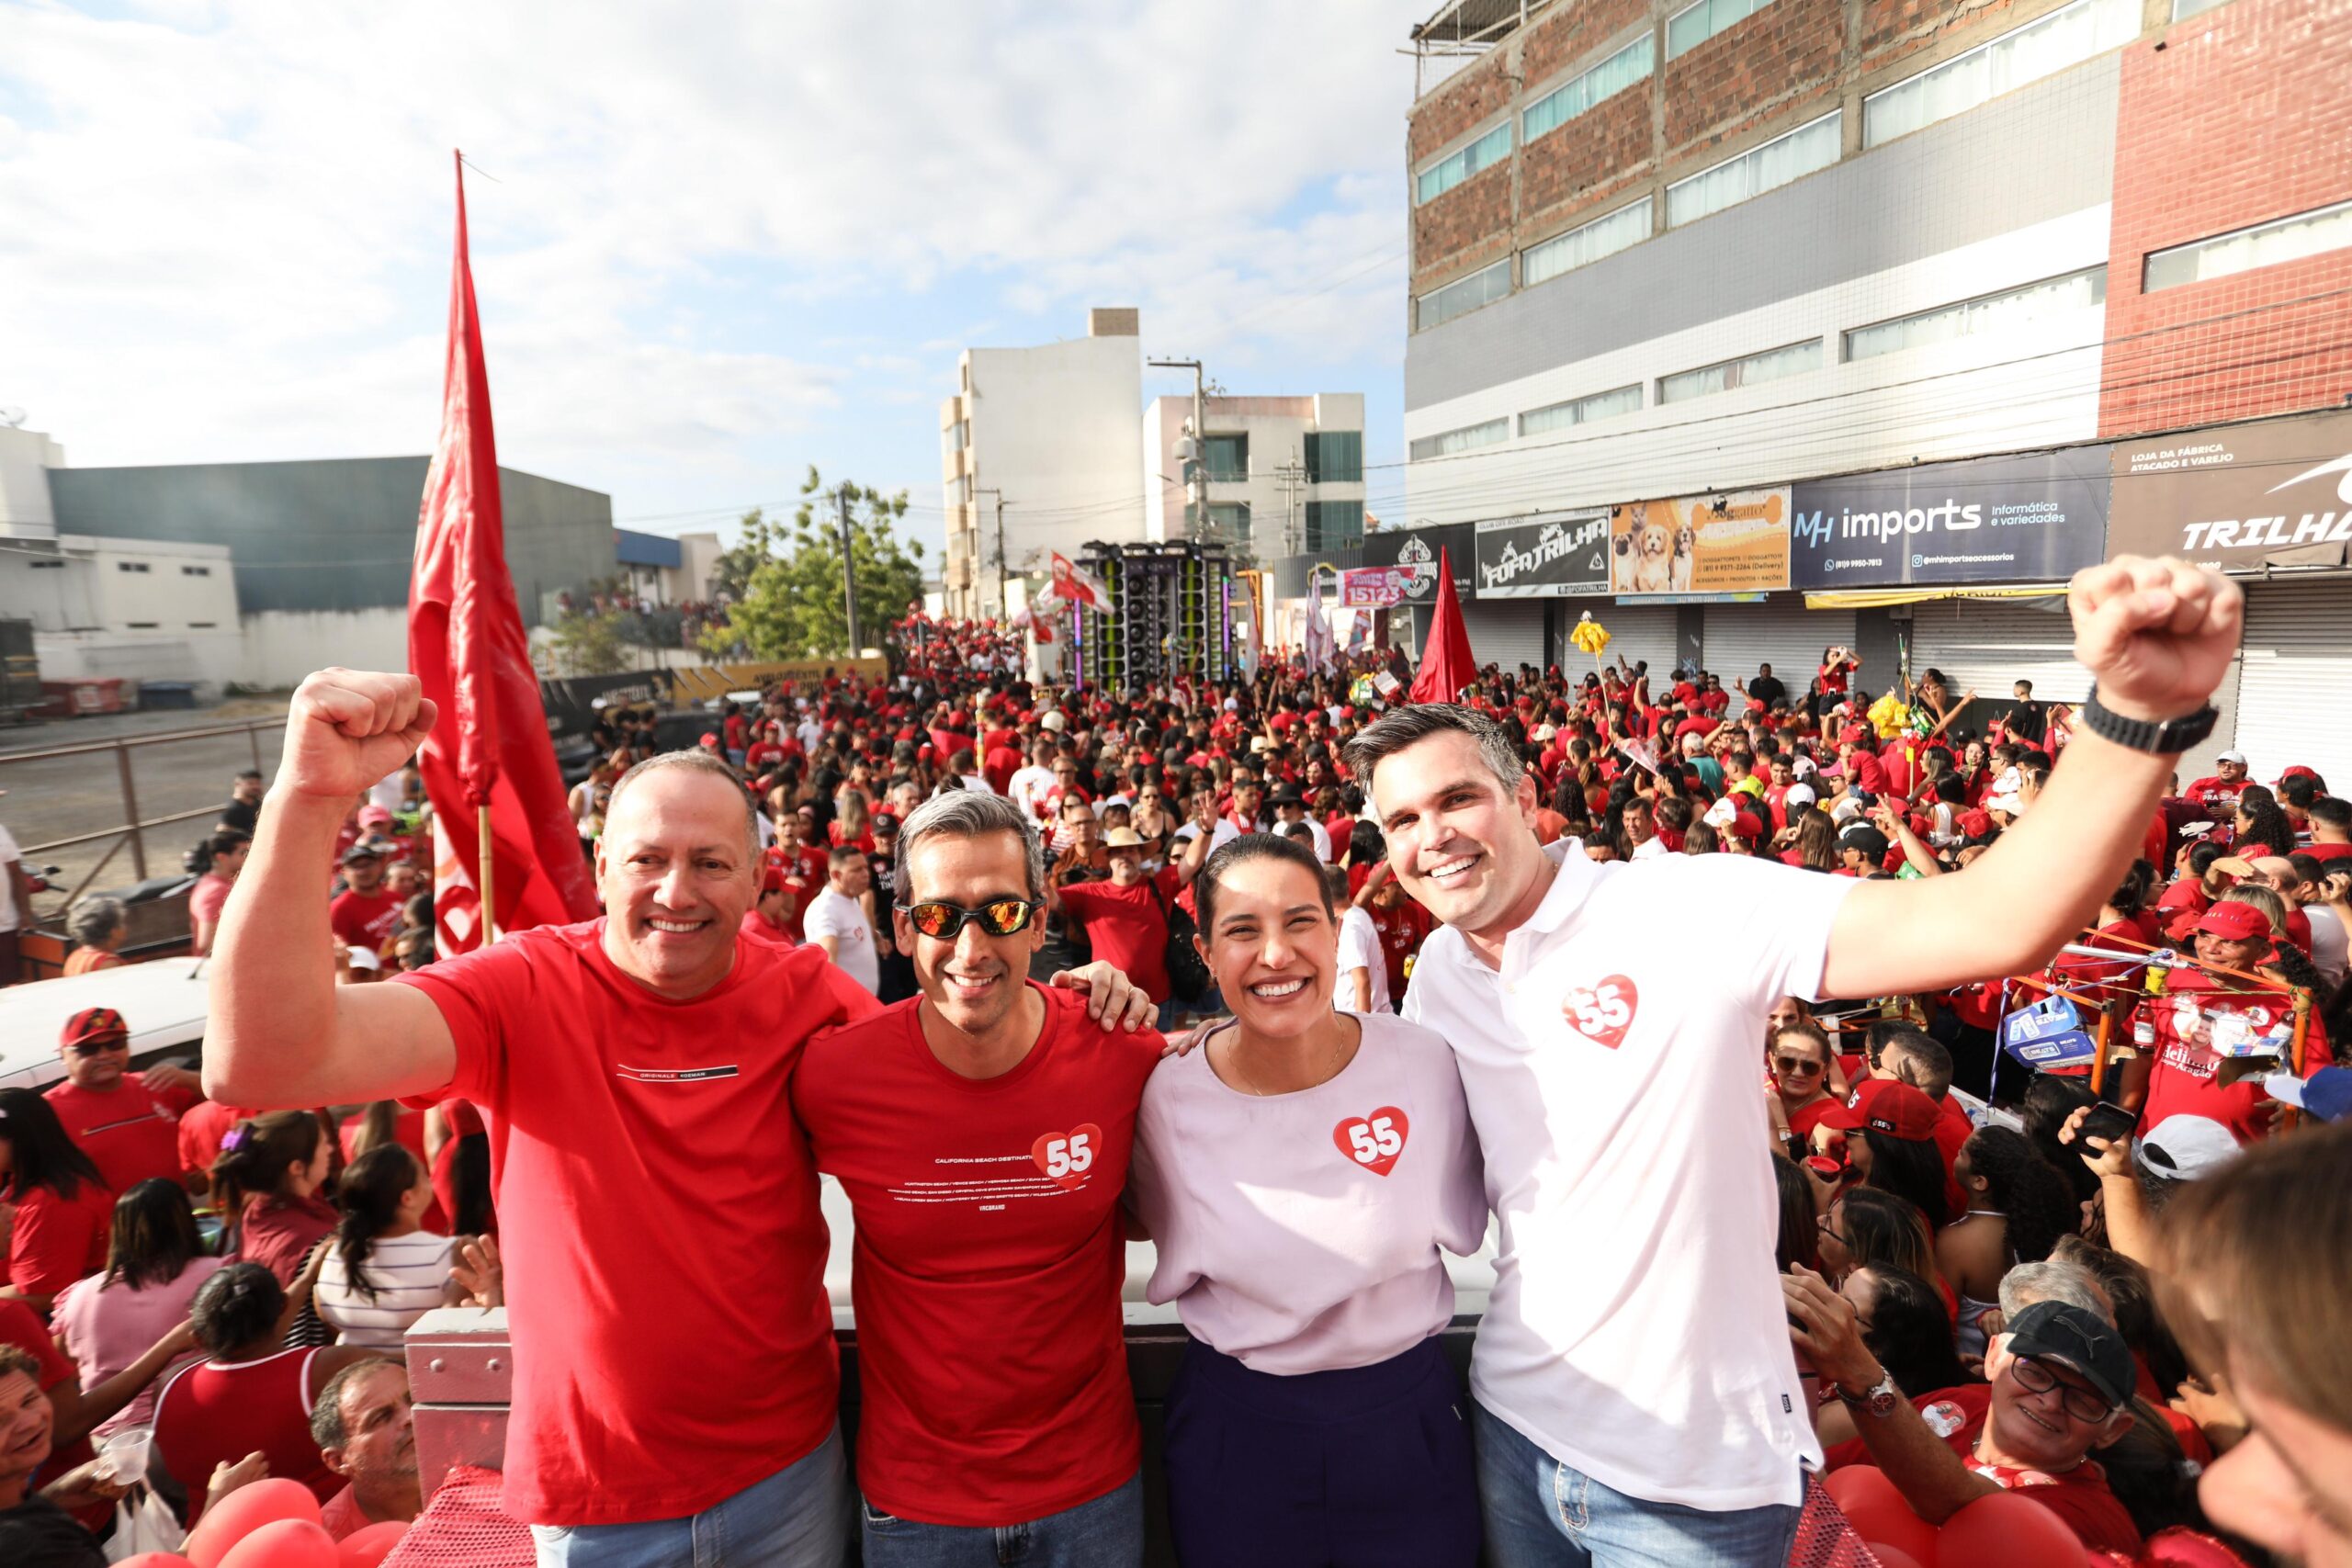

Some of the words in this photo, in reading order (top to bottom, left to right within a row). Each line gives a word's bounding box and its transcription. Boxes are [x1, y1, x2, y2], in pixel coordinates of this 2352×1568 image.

[2131, 460, 2179, 472] ATACADO
[2190, 454, 2233, 466] VAREJO
[2132, 451, 2157, 463] LOJA
[2159, 450, 2175, 458] DA
[2177, 444, 2224, 457] FÁBRICA
[1992, 502, 2058, 516] Informática
[1793, 511, 1834, 548] MH
[1842, 499, 1982, 544] imports
[1991, 518, 1998, 526] e
[2001, 513, 2065, 525] variedades
[1752, 561, 1783, 570] (Delivery)
[1573, 984, 1630, 1035] 55
[1349, 1116, 1402, 1163] 55
[1046, 1133, 1092, 1178] 55
